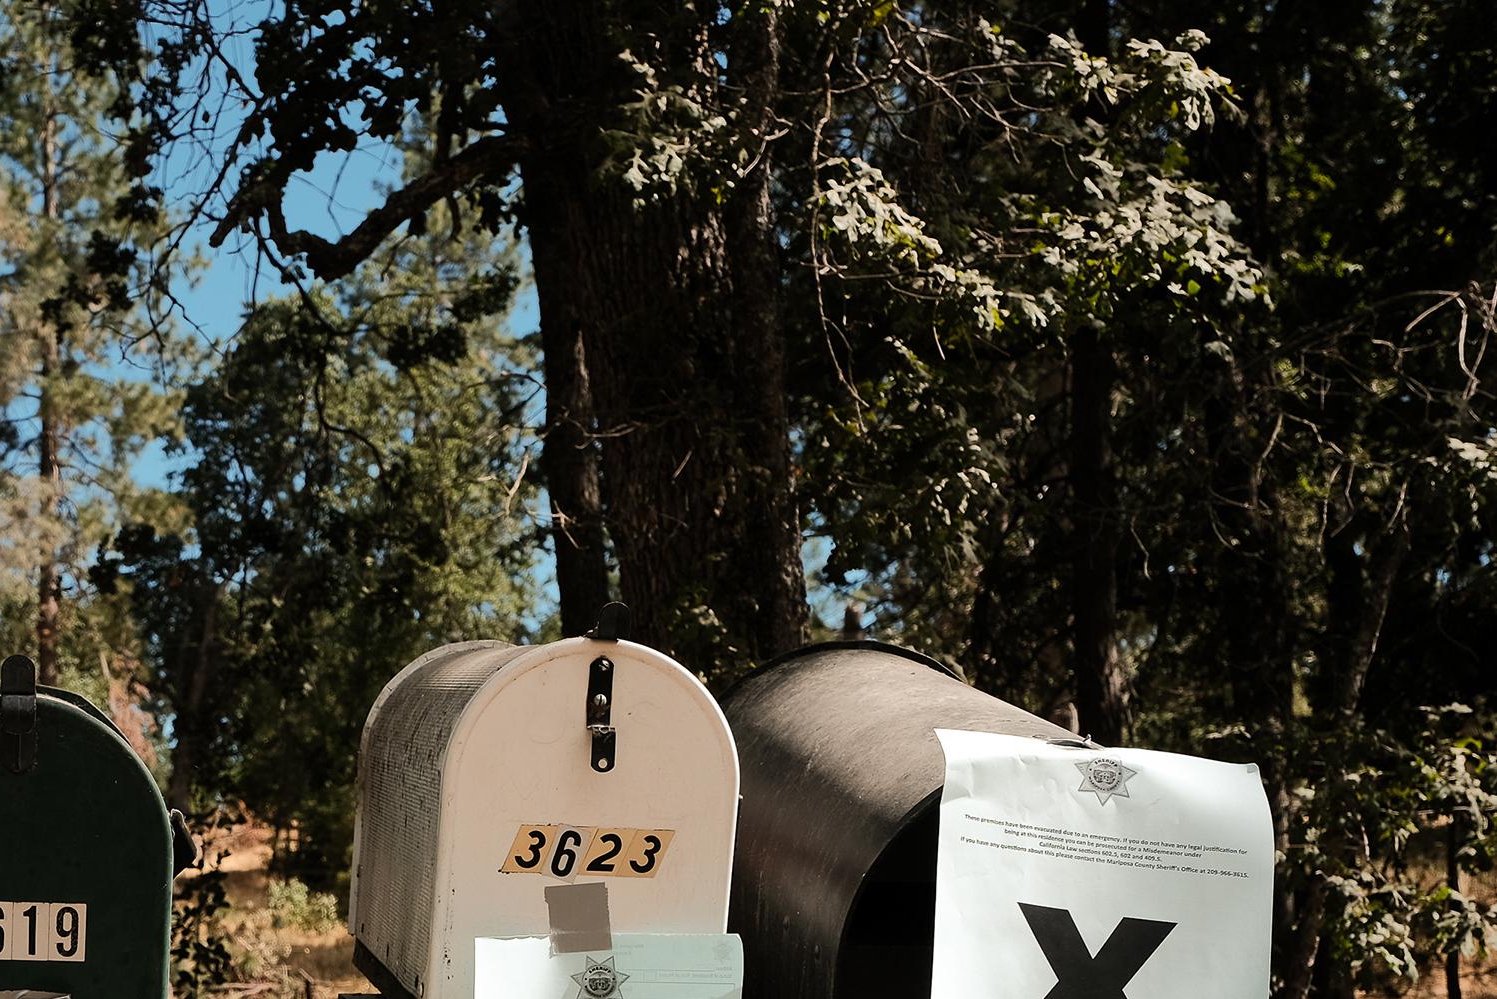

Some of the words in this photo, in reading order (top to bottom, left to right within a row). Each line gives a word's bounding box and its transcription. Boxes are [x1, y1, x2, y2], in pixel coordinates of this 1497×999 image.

[965, 814, 980, 822] These
[980, 818, 1004, 826] premises
[1034, 826, 1062, 835] evacuated
[1089, 834, 1122, 843] emergency.
[1203, 845, 1238, 854] justification
[1004, 828, 1020, 837] being
[1038, 834, 1064, 843] residence
[1095, 842, 1127, 851] prosecuted
[1142, 847, 1183, 856] Misdemeanor
[1039, 841, 1066, 850] California
[515, 830, 661, 877] 3623
[1000, 844, 1027, 852] questions
[1055, 851, 1074, 860] please
[1106, 859, 1134, 867] Mariposa
[1134, 861, 1156, 870] County
